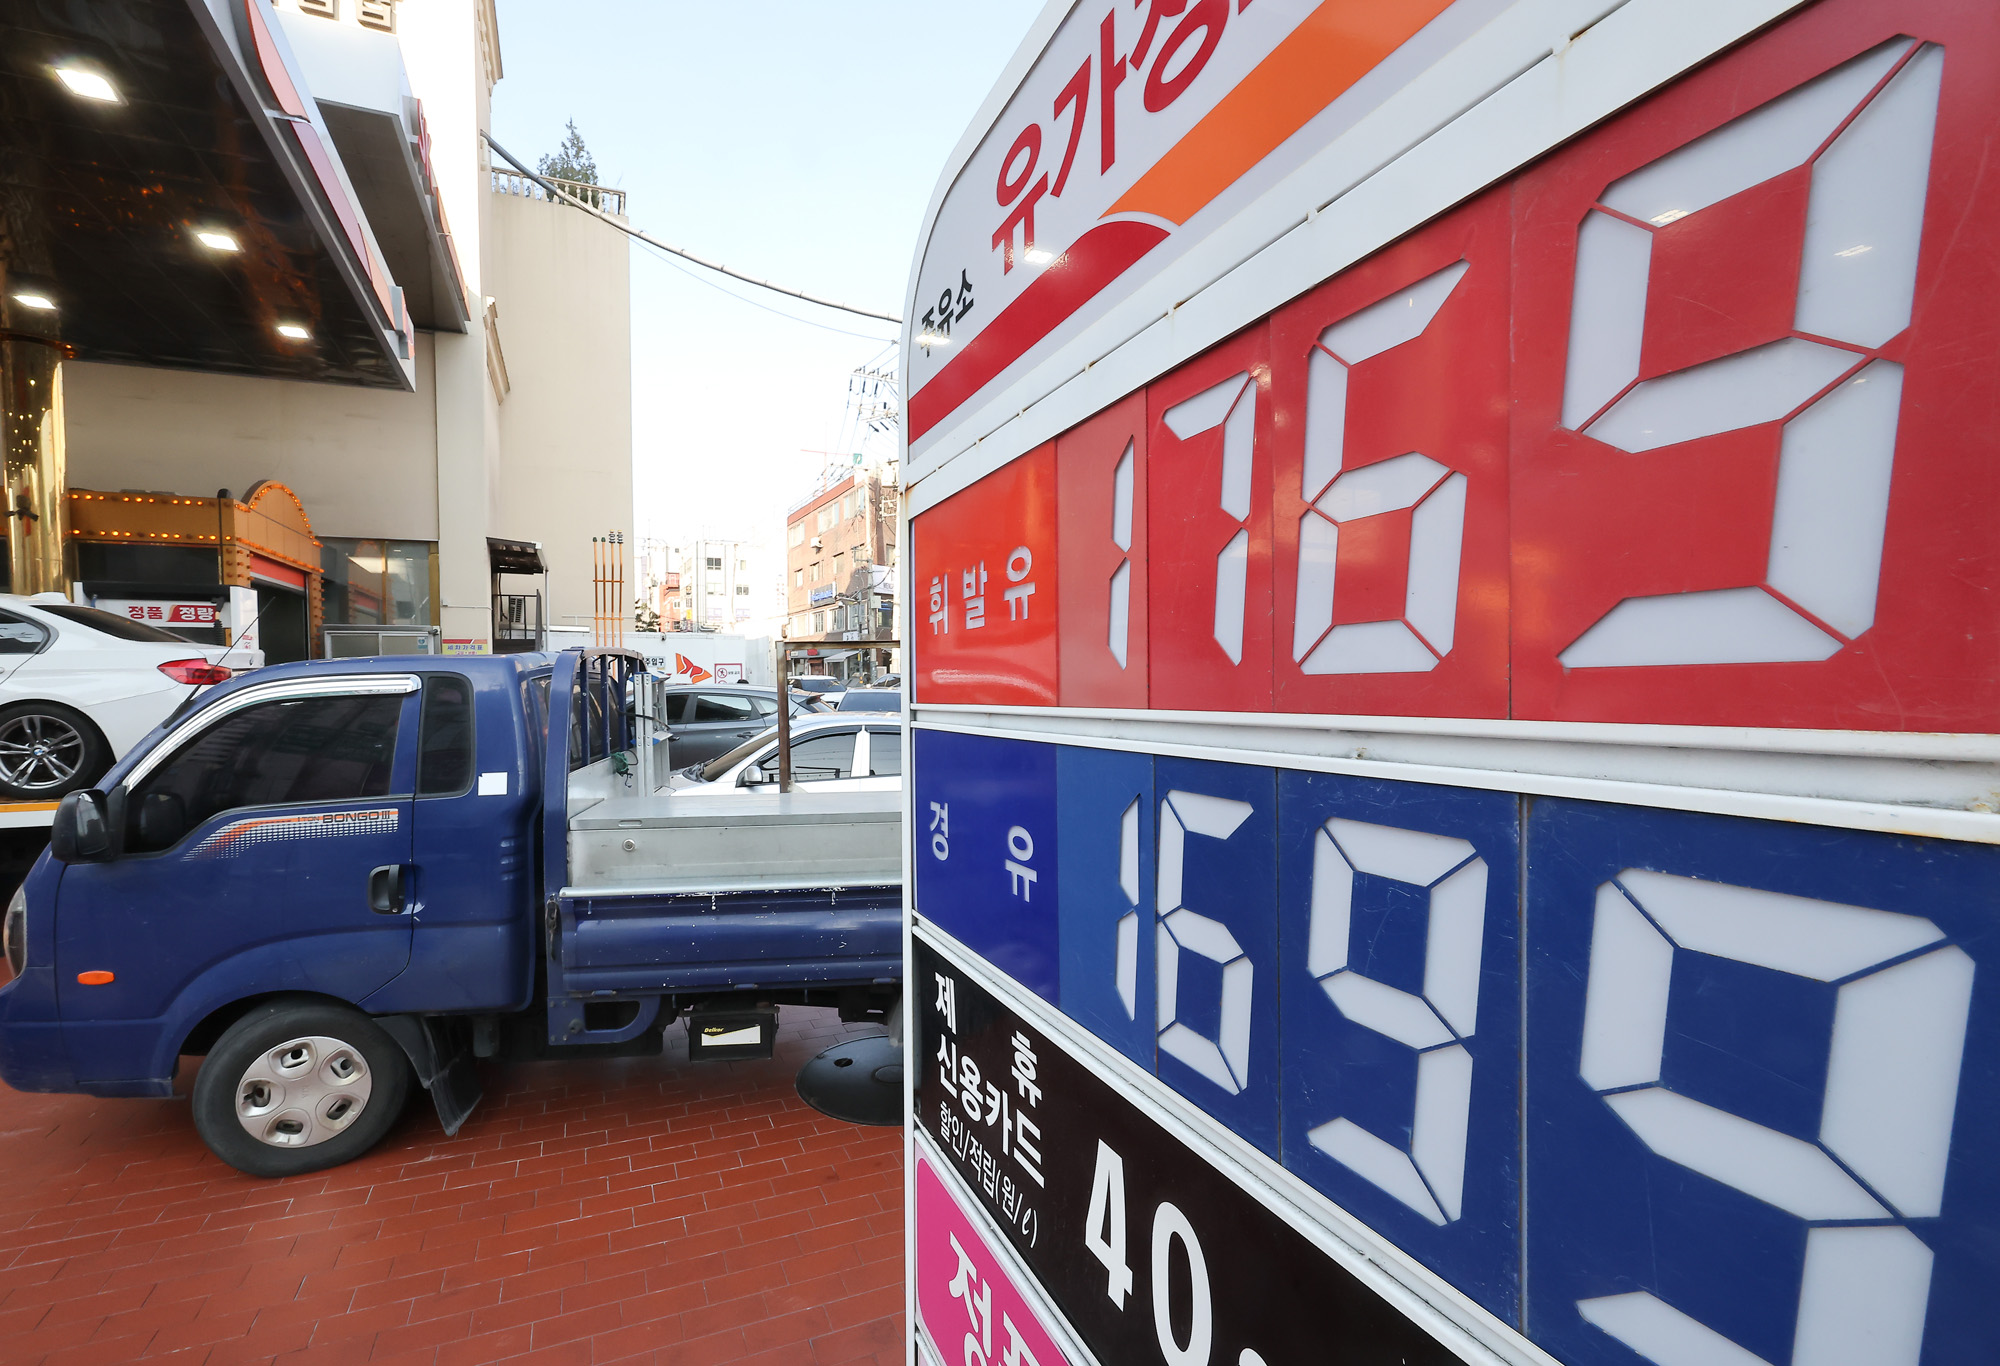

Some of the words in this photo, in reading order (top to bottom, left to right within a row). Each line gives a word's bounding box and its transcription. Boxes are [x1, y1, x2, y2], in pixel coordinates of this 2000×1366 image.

[921, 268, 974, 357] 주유소
[929, 545, 1036, 636] 휘발유
[1107, 33, 1945, 674] 1769
[128, 606, 163, 620] 정품
[179, 607, 214, 621] 정량
[323, 812, 380, 823] BONGO
[936, 1033, 1045, 1189] 신용카드
[1114, 788, 1976, 1366] 1699
